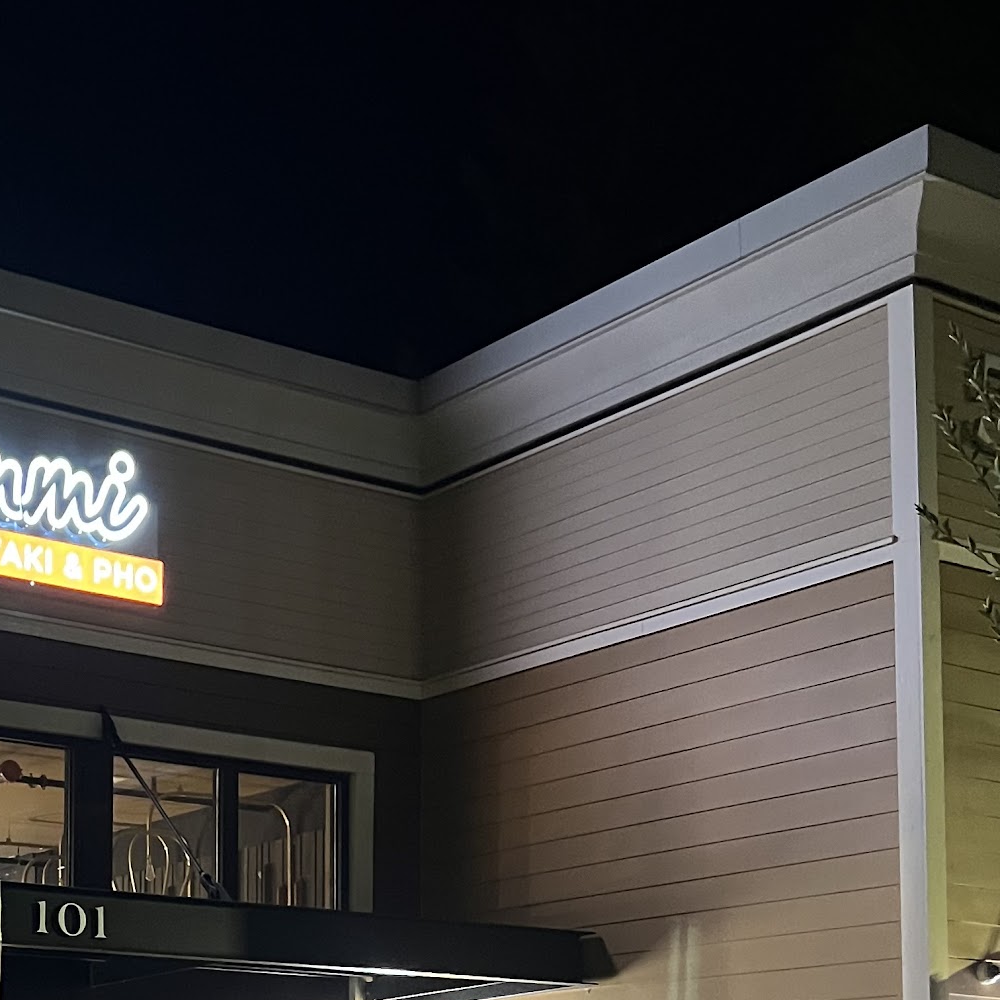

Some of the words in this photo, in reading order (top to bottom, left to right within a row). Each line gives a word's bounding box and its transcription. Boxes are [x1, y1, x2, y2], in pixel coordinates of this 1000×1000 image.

[63, 552, 83, 580] &
[93, 557, 158, 593] PHO
[36, 900, 107, 939] 101
